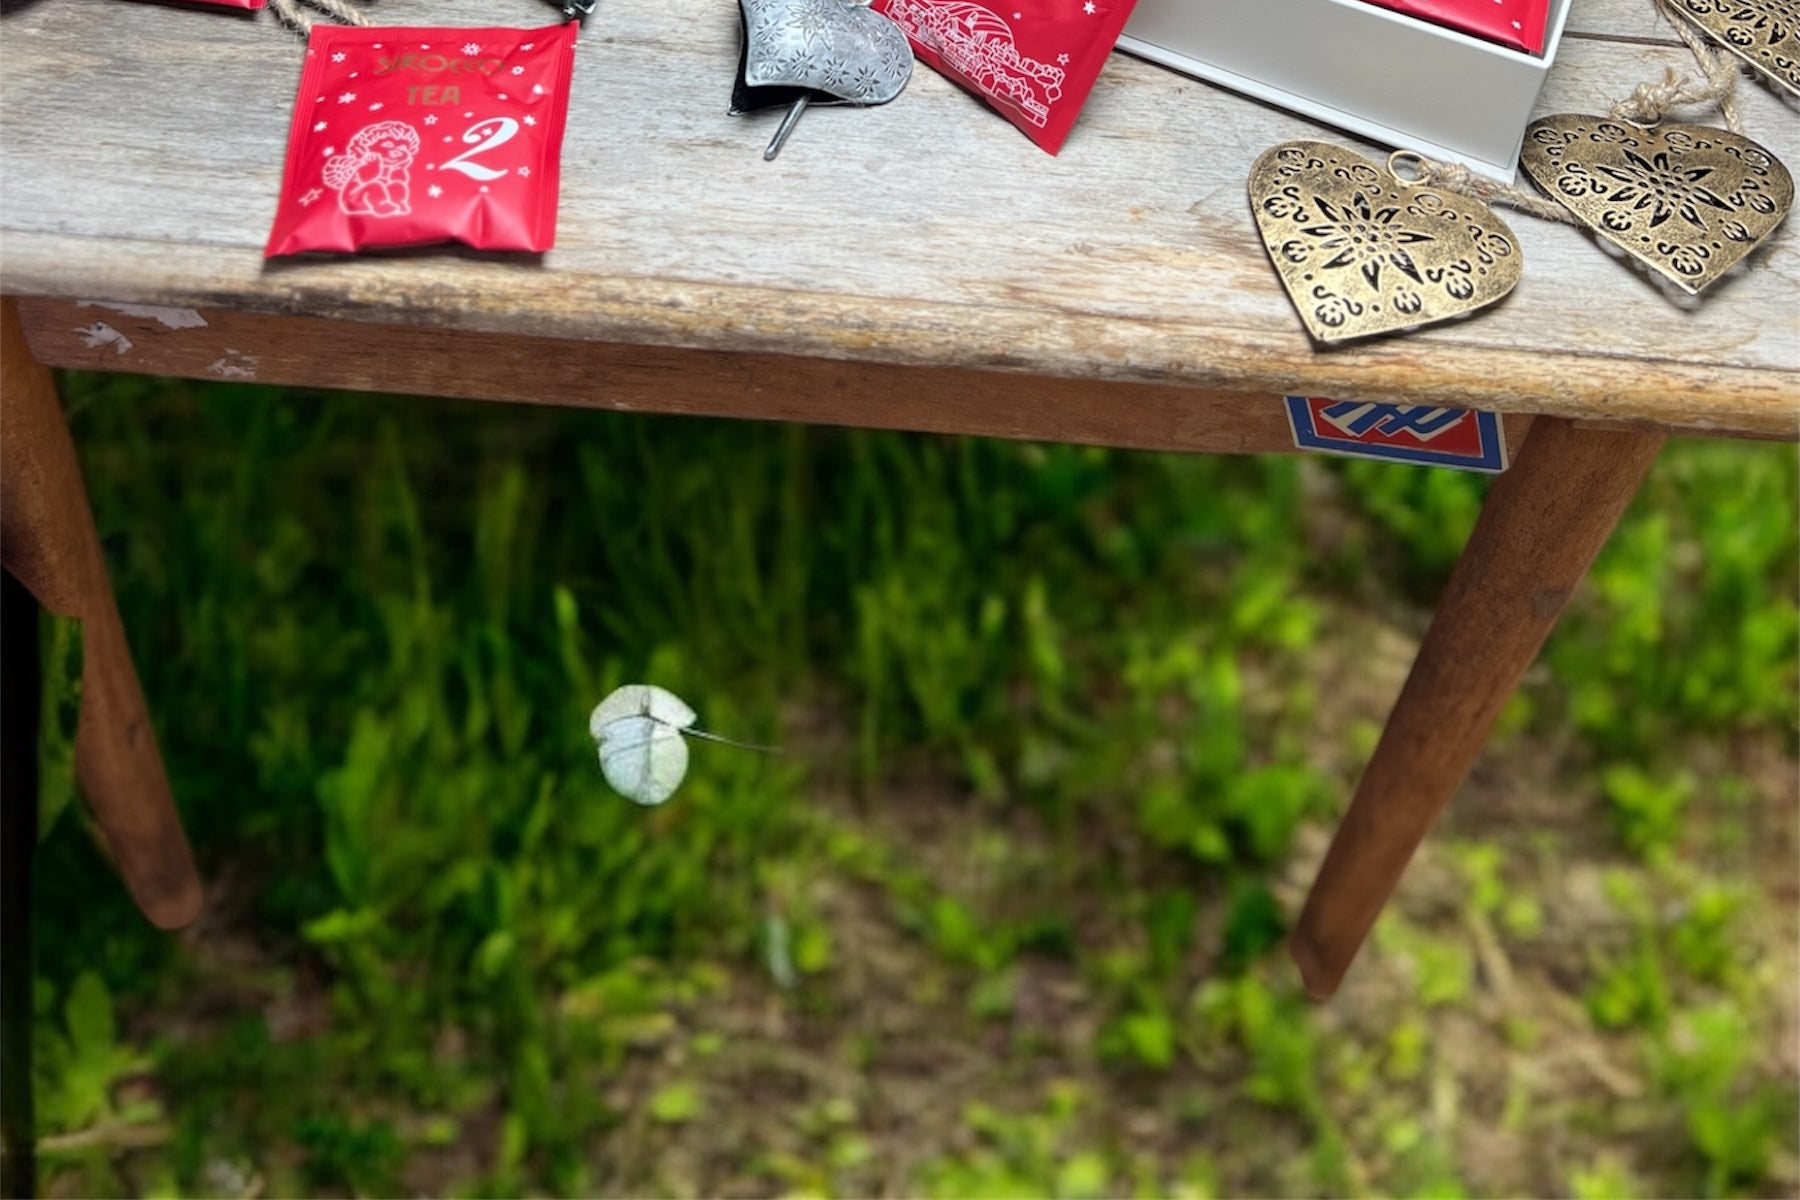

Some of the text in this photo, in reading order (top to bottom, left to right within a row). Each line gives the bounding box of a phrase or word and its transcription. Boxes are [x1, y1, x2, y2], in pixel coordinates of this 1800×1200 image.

[374, 51, 506, 76] SIROCCO
[407, 83, 461, 106] TEA
[438, 116, 520, 181] 2
